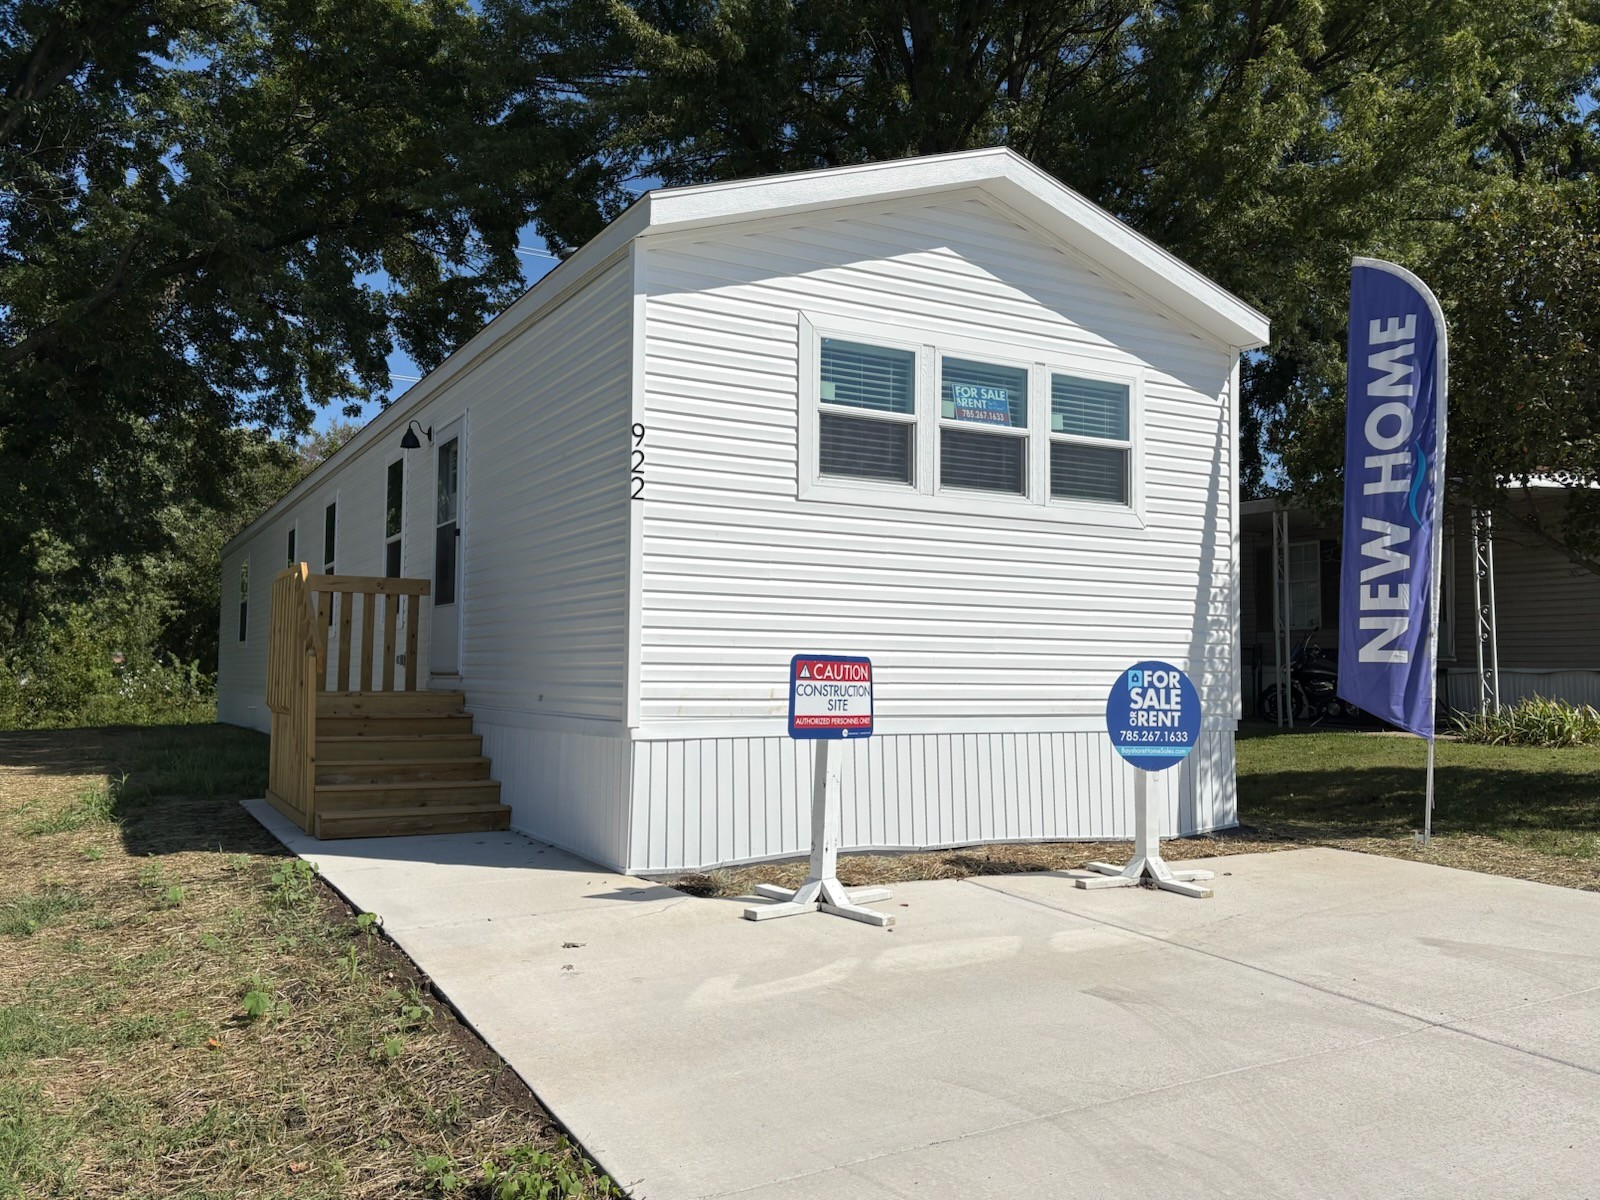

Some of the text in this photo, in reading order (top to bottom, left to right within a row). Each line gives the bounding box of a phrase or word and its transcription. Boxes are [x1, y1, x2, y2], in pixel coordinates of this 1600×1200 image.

[955, 386, 1006, 401] FOR SALE
[961, 398, 987, 409] RENT
[962, 409, 1004, 421] 785.267.1633
[631, 423, 645, 500] 922
[1358, 313, 1417, 664] NEW HOME
[813, 663, 869, 681] CAUTION
[1143, 670, 1181, 688] FOR
[796, 684, 870, 697] CONSTRUCTION
[827, 699, 848, 711] SITE
[1130, 687, 1181, 710] SALE
[796, 717, 830, 725] AUTHORIZED
[831, 717, 859, 725] PERSONNEL
[1129, 711, 1181, 727] OR RENT
[1120, 731, 1188, 742] 785.267.1633
[1121, 747, 1187, 755] BayshoreHomeSales.com
